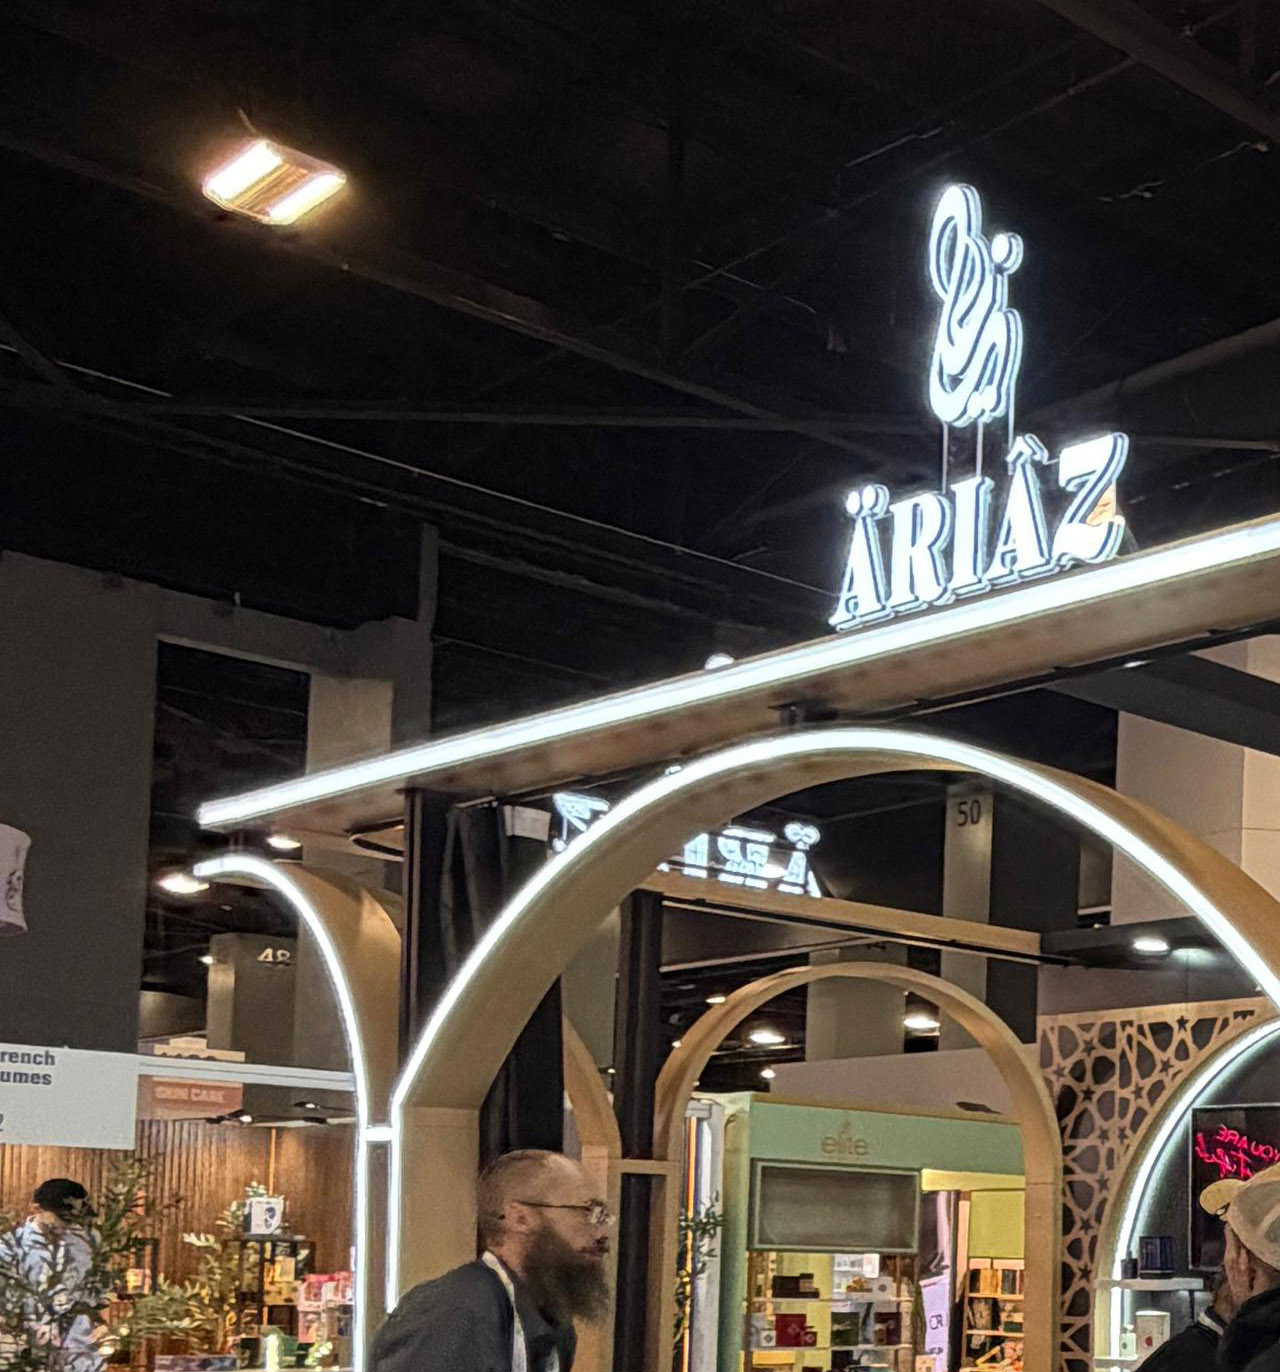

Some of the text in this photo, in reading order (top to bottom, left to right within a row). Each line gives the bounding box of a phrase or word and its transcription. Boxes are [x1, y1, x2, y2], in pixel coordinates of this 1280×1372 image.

[828, 432, 1130, 632] ÄRIÂZ
[956, 799, 982, 827] 50
[0, 1049, 56, 1066] rench
[0, 1070, 53, 1086] umes
